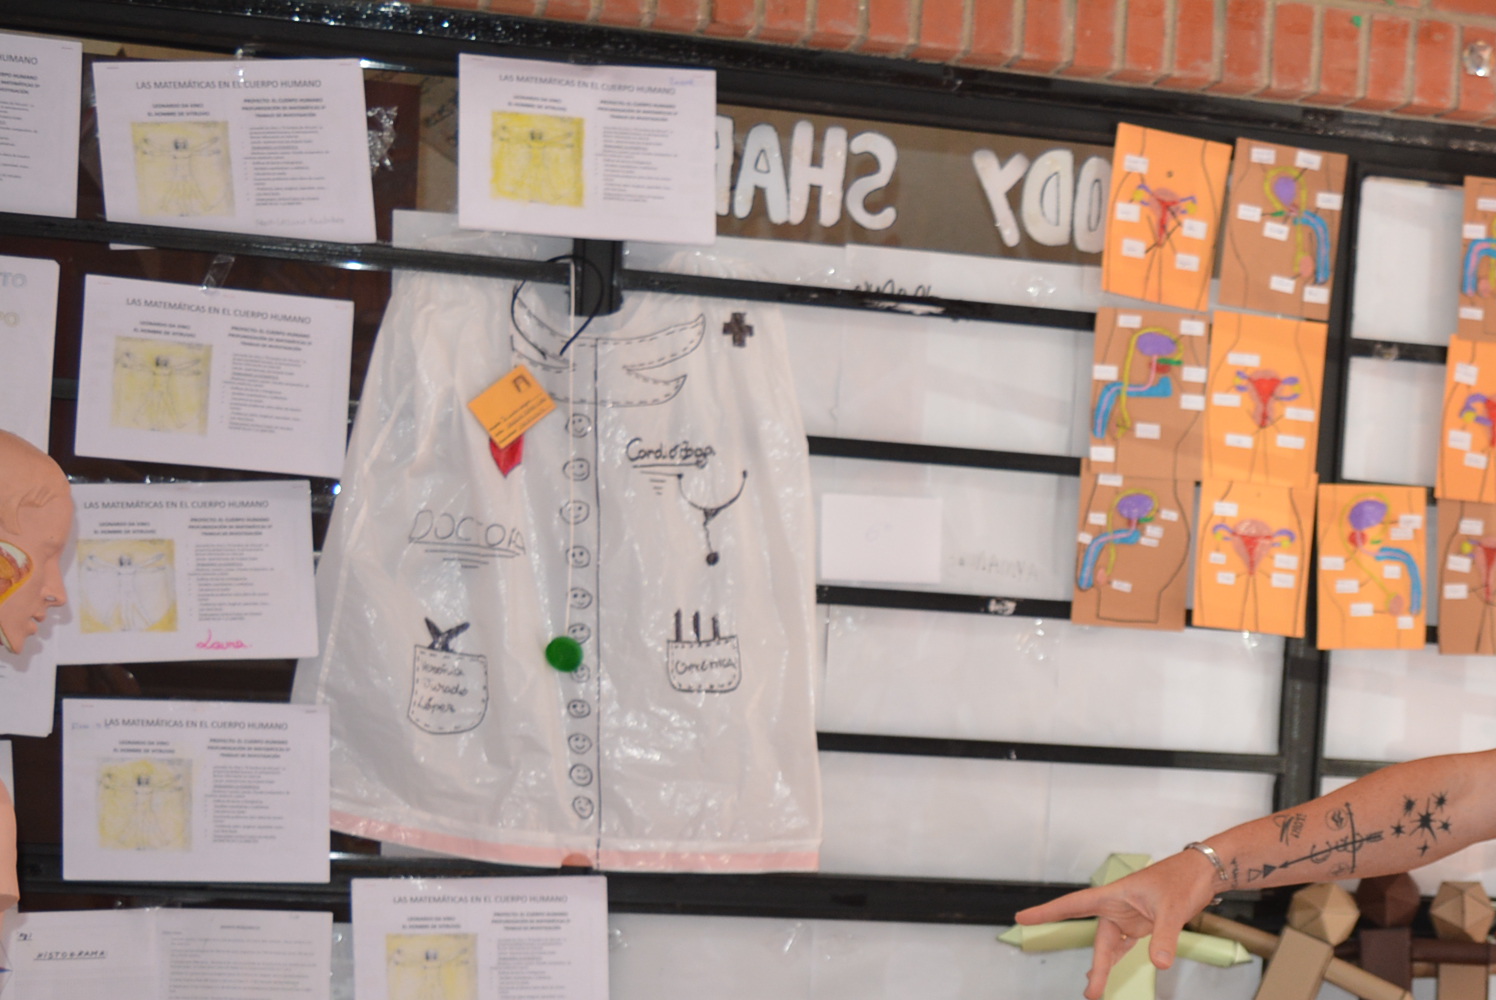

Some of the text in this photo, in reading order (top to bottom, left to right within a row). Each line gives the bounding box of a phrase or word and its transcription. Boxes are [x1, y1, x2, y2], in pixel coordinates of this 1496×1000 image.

[136, 81, 151, 90] LAS
[217, 80, 229, 89] EN
[231, 80, 243, 89] EL
[244, 80, 279, 89] CUERPO
[281, 79, 321, 88] HUMANO
[127, 298, 141, 308] LAS
[207, 306, 219, 315] EN
[221, 307, 232, 317] EL
[233, 308, 268, 320] CUERPO
[271, 312, 311, 325] HUMANO
[105, 718, 119, 727] LAS
[185, 720, 197, 729] EN
[199, 720, 210, 729] EL
